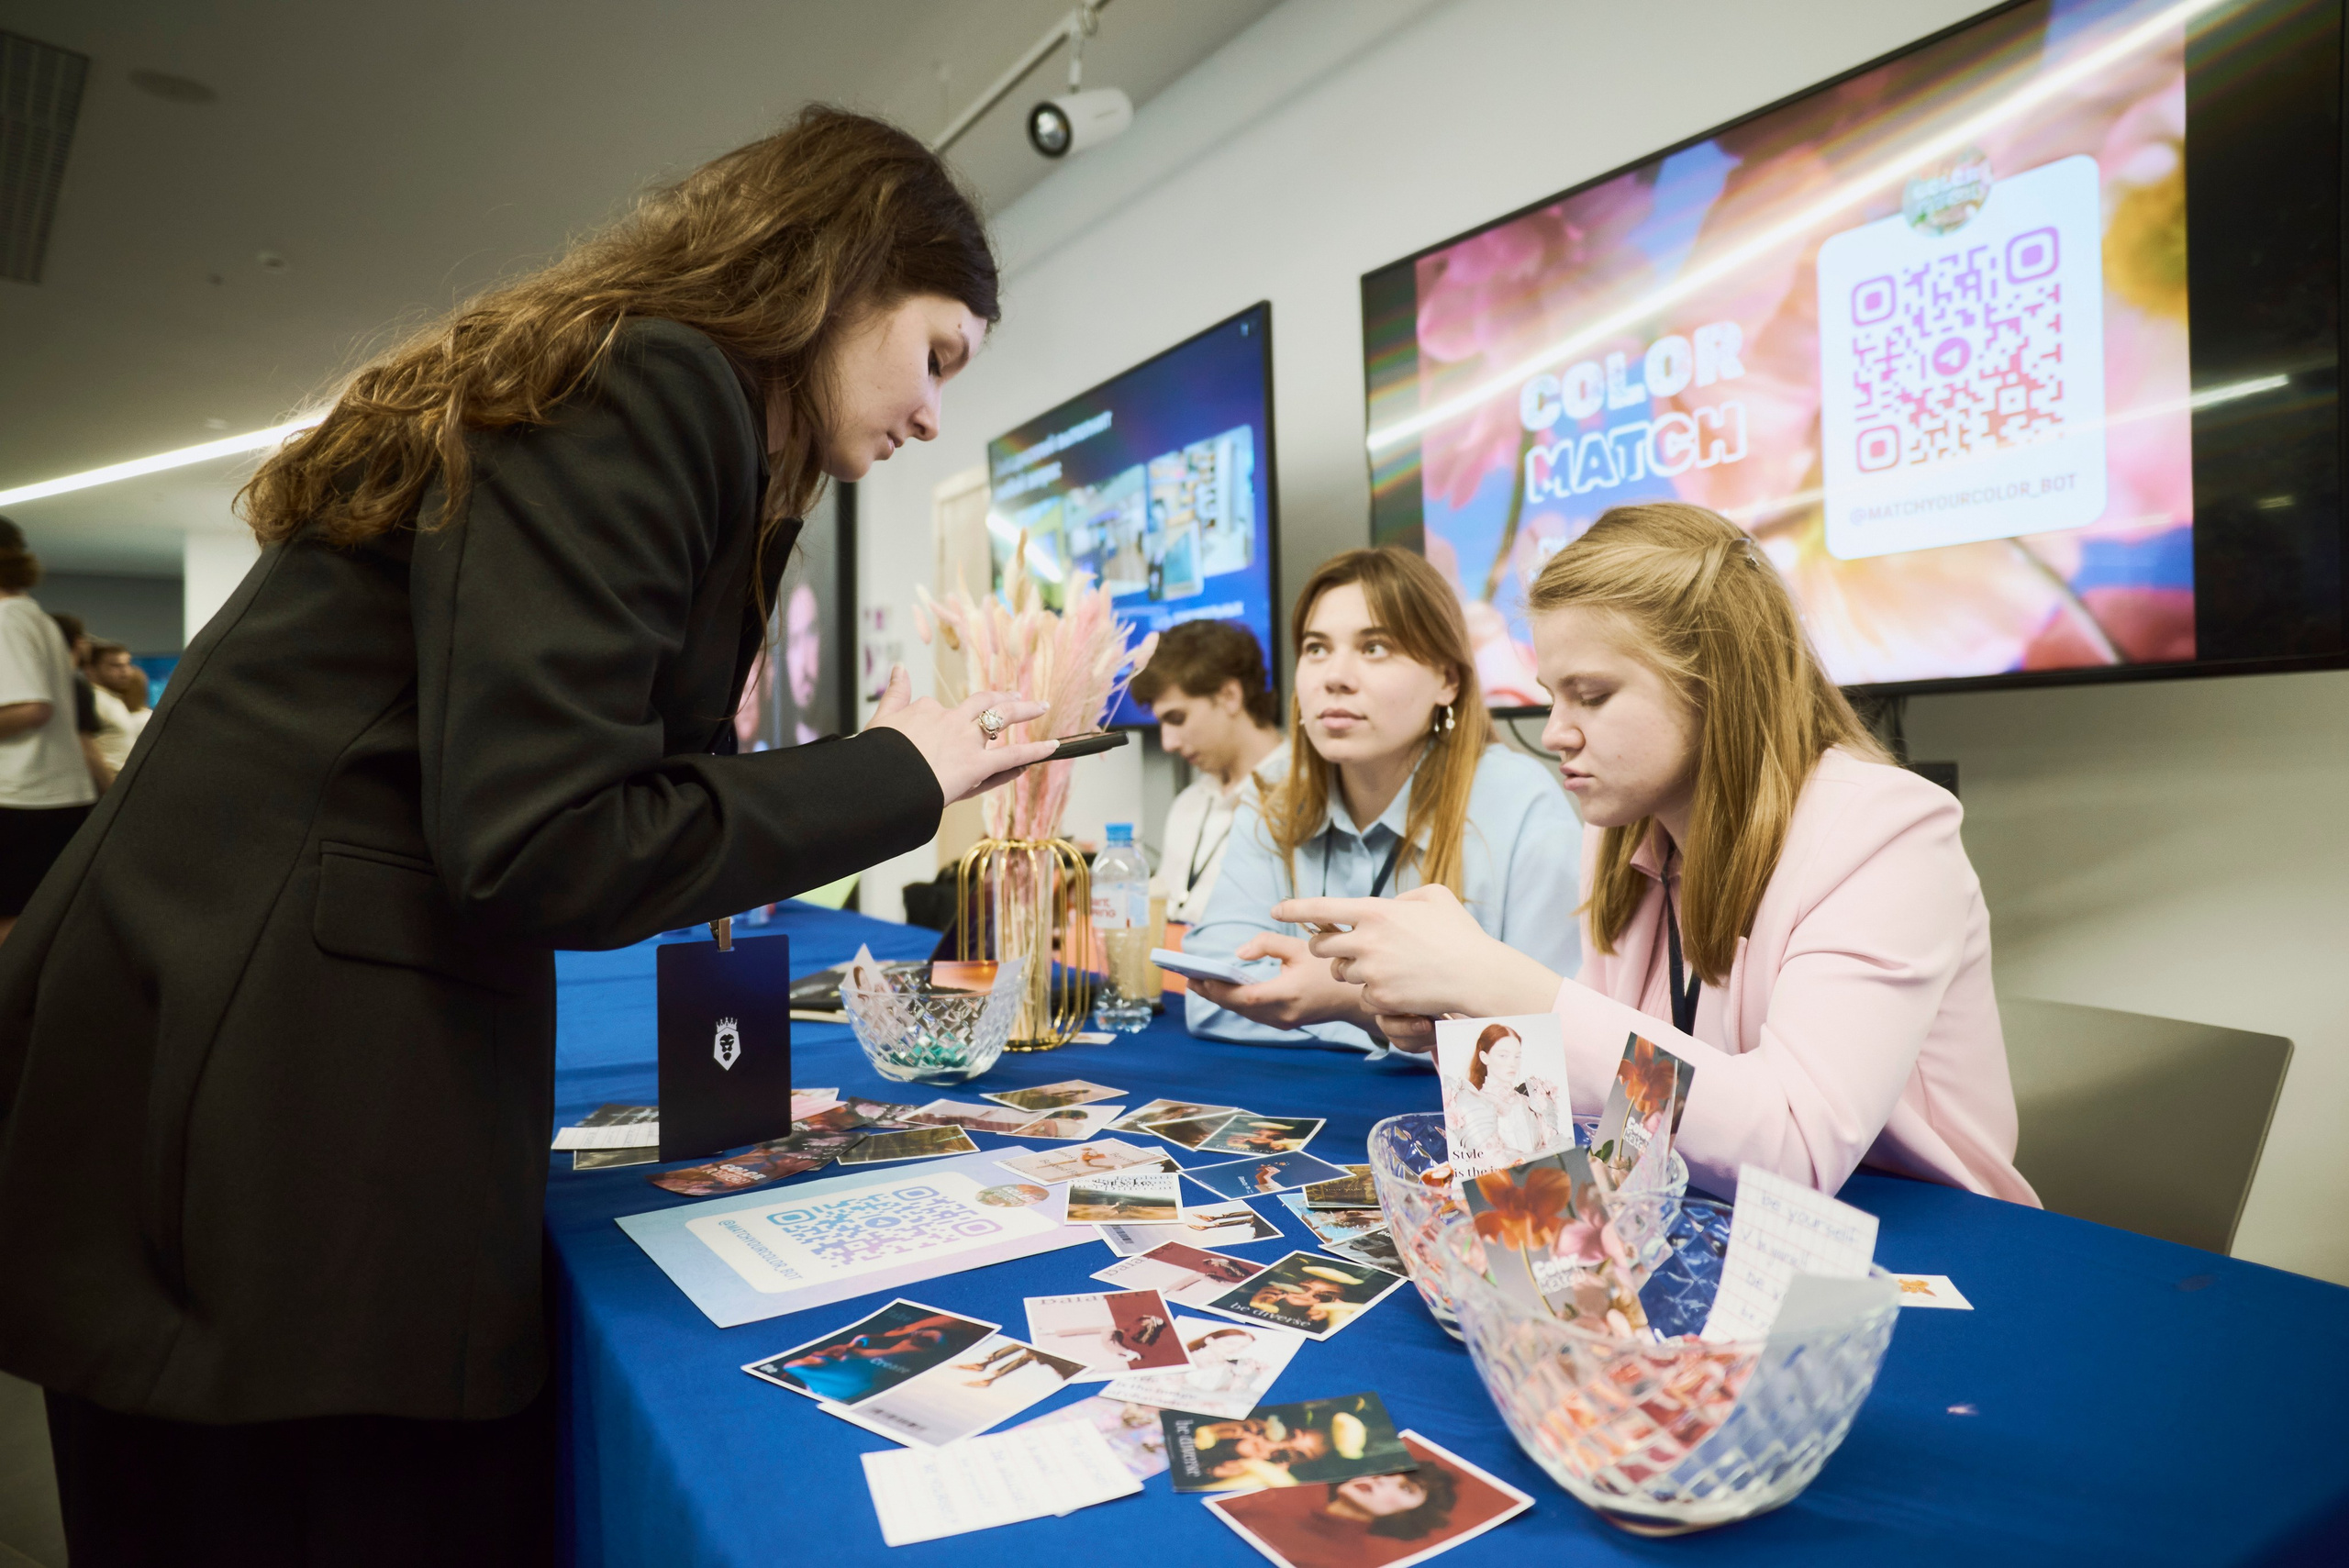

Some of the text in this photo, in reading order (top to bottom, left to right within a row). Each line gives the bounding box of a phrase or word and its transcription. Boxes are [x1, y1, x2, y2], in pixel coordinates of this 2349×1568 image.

[1520, 321, 1745, 431] COLOR
[1524, 399, 1748, 505] MATCH
[1850, 473, 2077, 525] @MATCHYOURCOLOR_BOT
[1453, 1149, 1484, 1162] Style
[1454, 1168, 1464, 1178] is
[1467, 1166, 1487, 1177] the
[718, 1219, 804, 1281] @MATCHYOURCOLOR_BOT
[1230, 1301, 1311, 1328] be diverse
